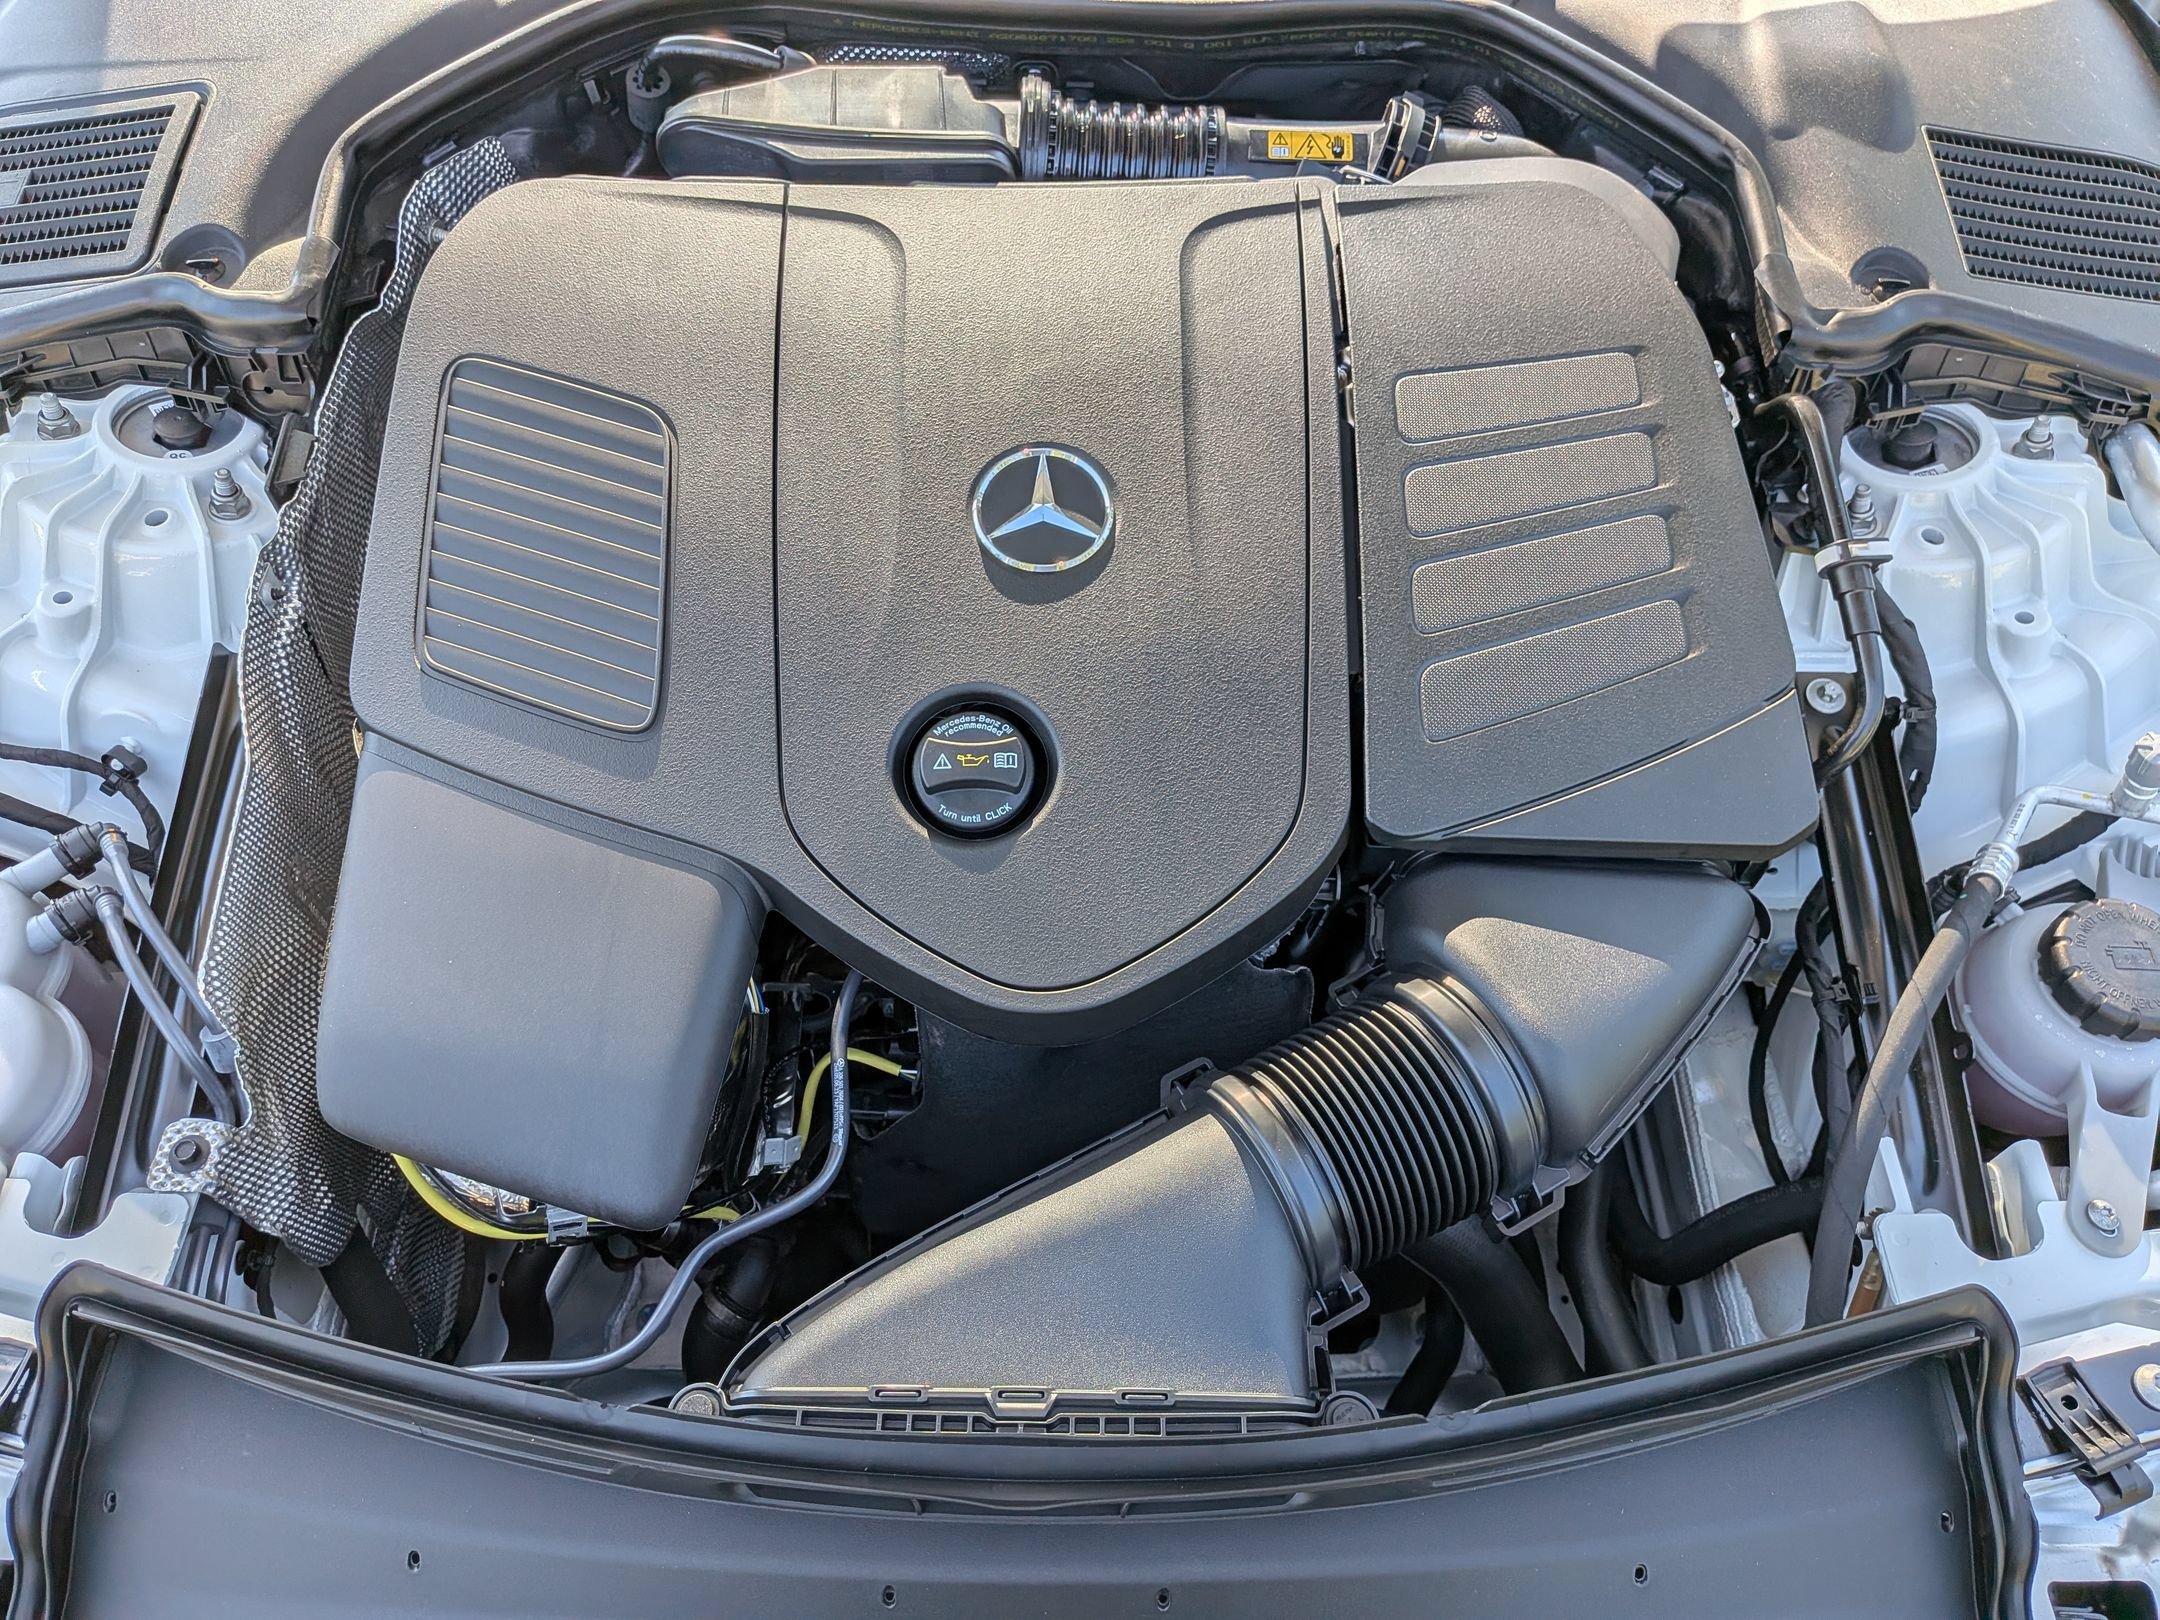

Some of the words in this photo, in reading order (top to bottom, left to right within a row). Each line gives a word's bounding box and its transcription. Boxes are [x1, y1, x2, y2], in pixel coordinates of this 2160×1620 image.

[932, 714, 1002, 737] Mercedes-Benz
[1001, 723, 1014, 735] Oil
[944, 721, 1004, 738] recommended
[938, 803, 958, 821] Turn
[960, 813, 981, 823] until
[985, 802, 1013, 821] CLICK
[2079, 917, 2097, 934] NOT
